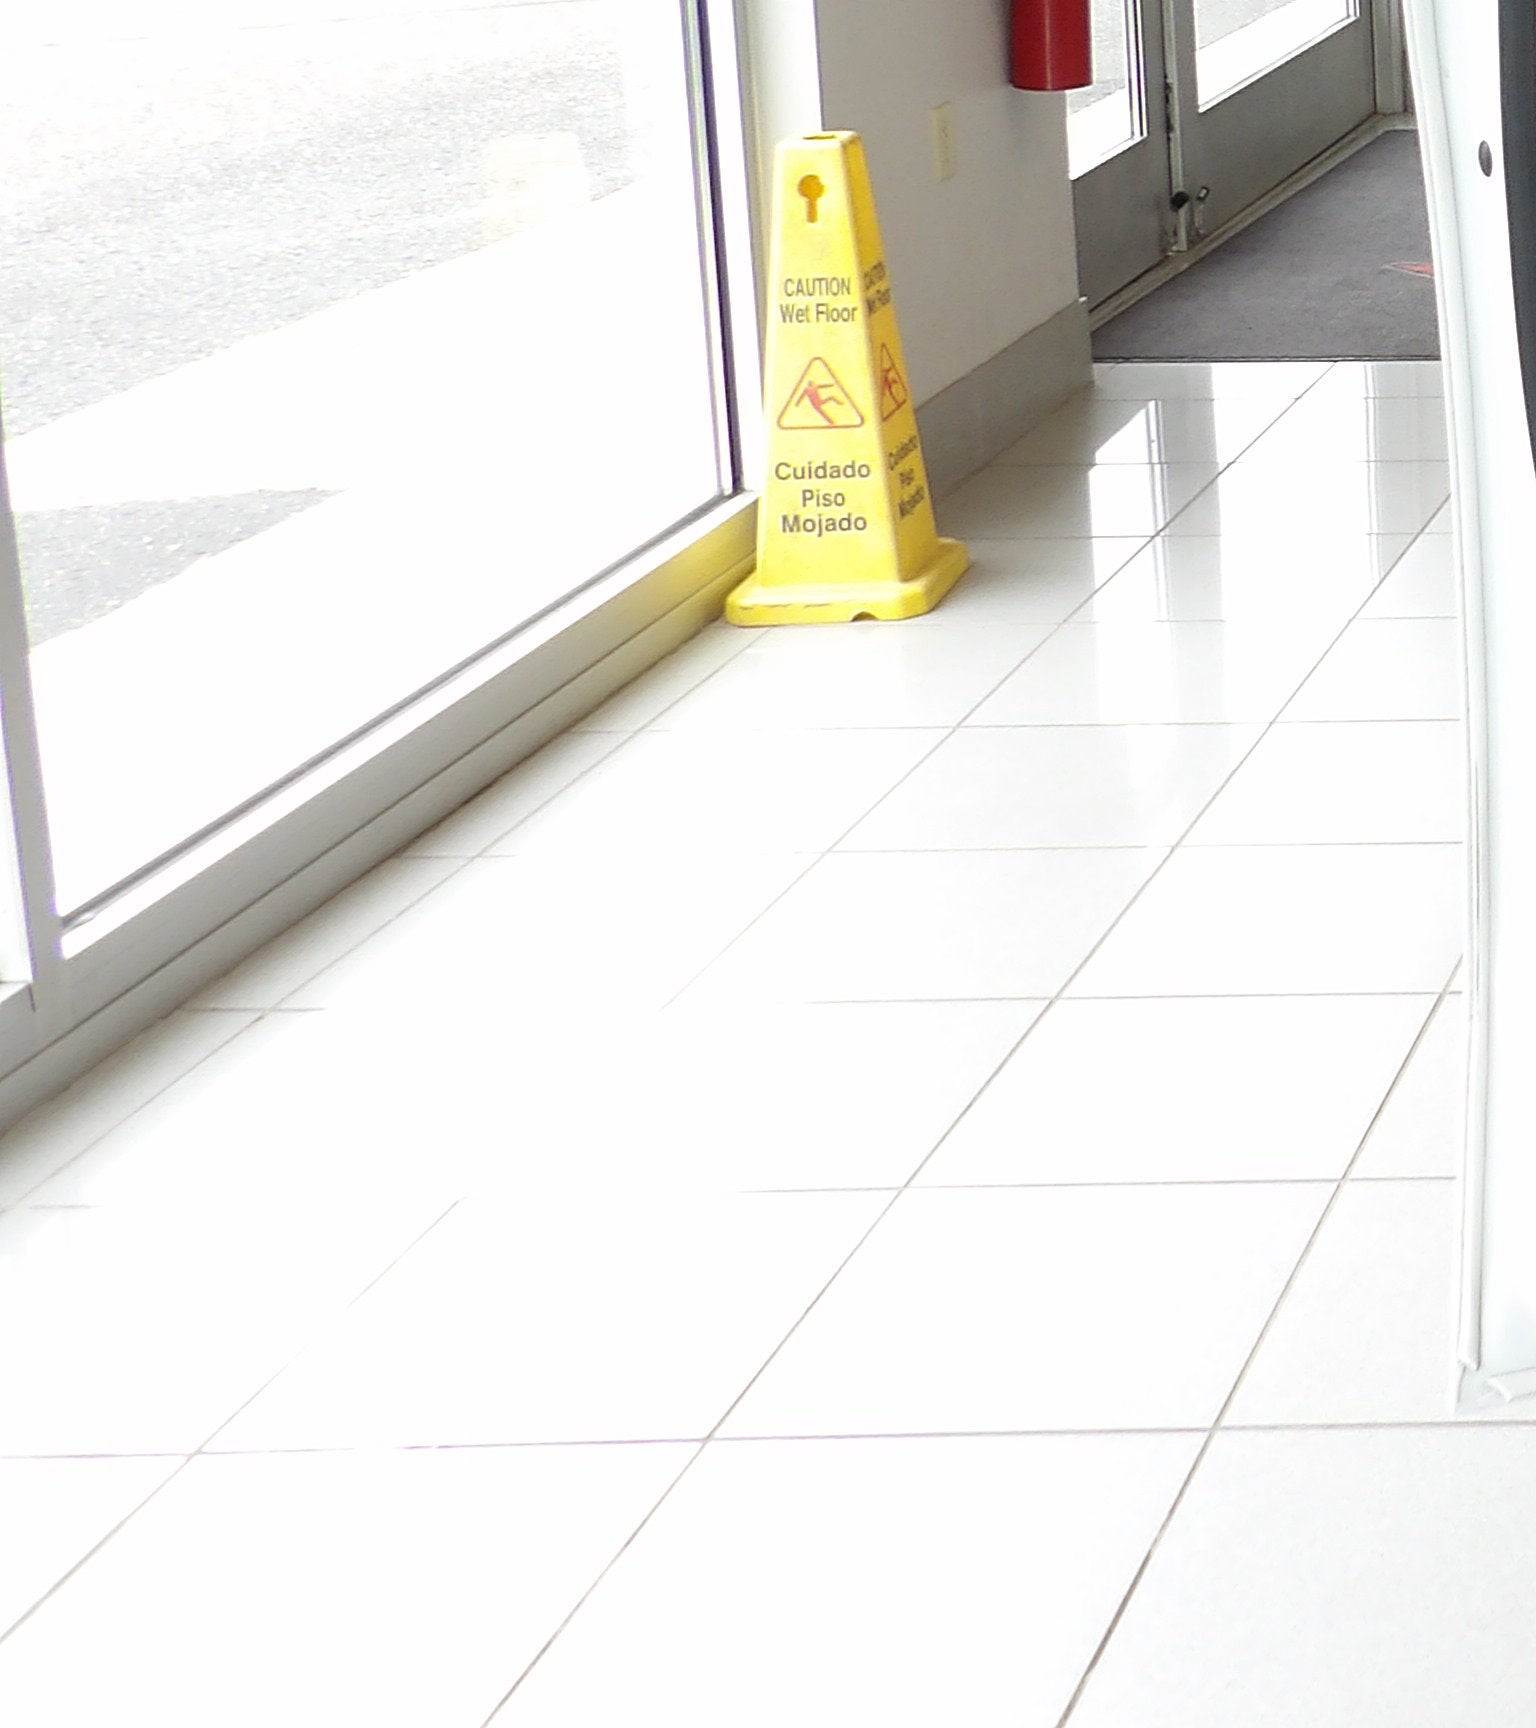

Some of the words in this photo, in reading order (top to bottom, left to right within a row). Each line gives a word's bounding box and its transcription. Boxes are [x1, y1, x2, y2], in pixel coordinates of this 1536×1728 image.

[784, 277, 851, 297] CAUTION
[780, 304, 811, 323] Wet
[816, 303, 857, 322] Floor
[775, 460, 871, 480] Cuidado
[802, 489, 845, 507] Piso
[782, 513, 867, 537] Mojado
